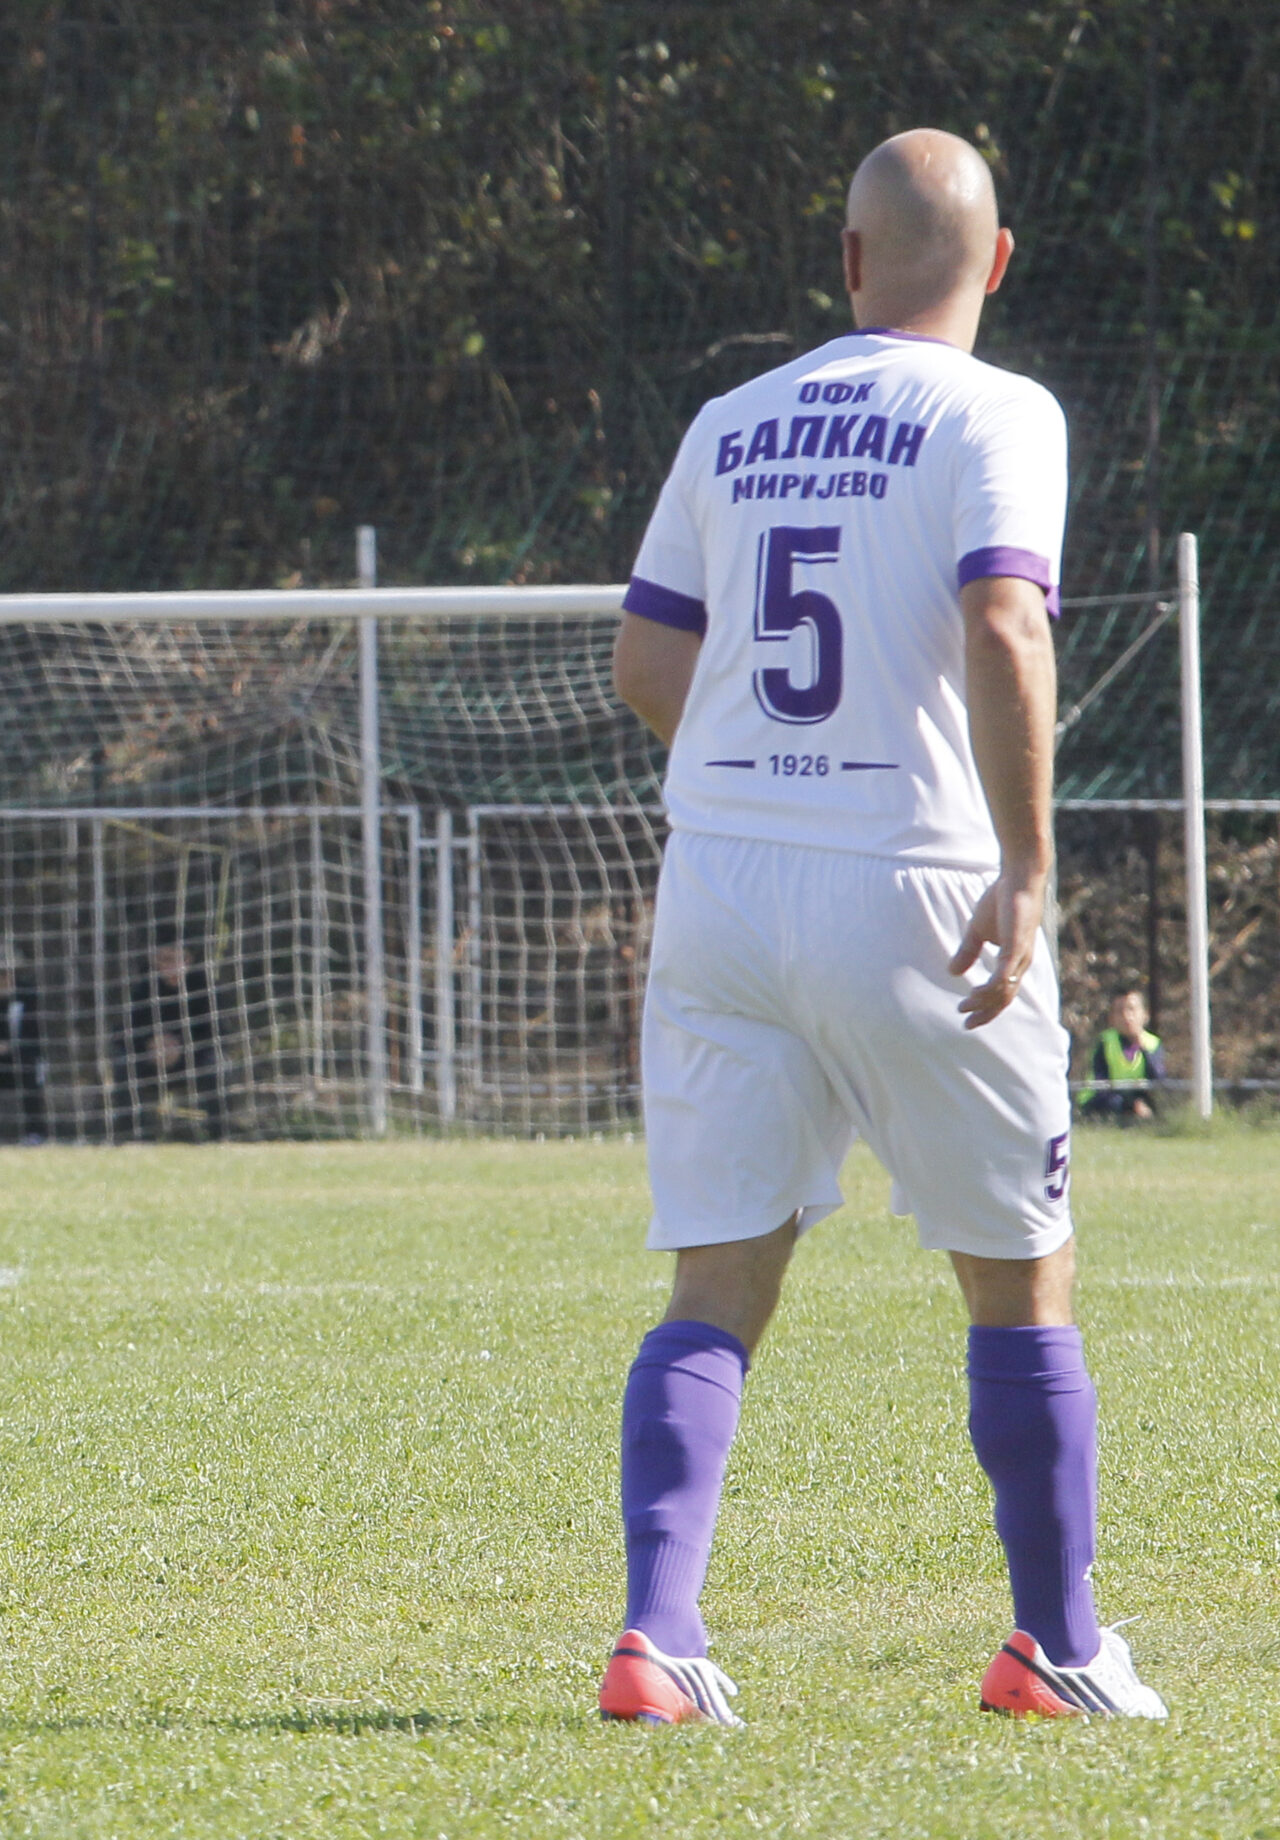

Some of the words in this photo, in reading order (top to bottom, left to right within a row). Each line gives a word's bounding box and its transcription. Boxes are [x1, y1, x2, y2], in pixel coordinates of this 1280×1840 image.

[799, 381, 876, 405] ОФК
[715, 414, 927, 476] БАЛКАН
[731, 470, 889, 503] МИРИЈЕВО
[753, 526, 844, 726] 5
[768, 754, 831, 777] 1926
[1044, 1131, 1069, 1202] 5
